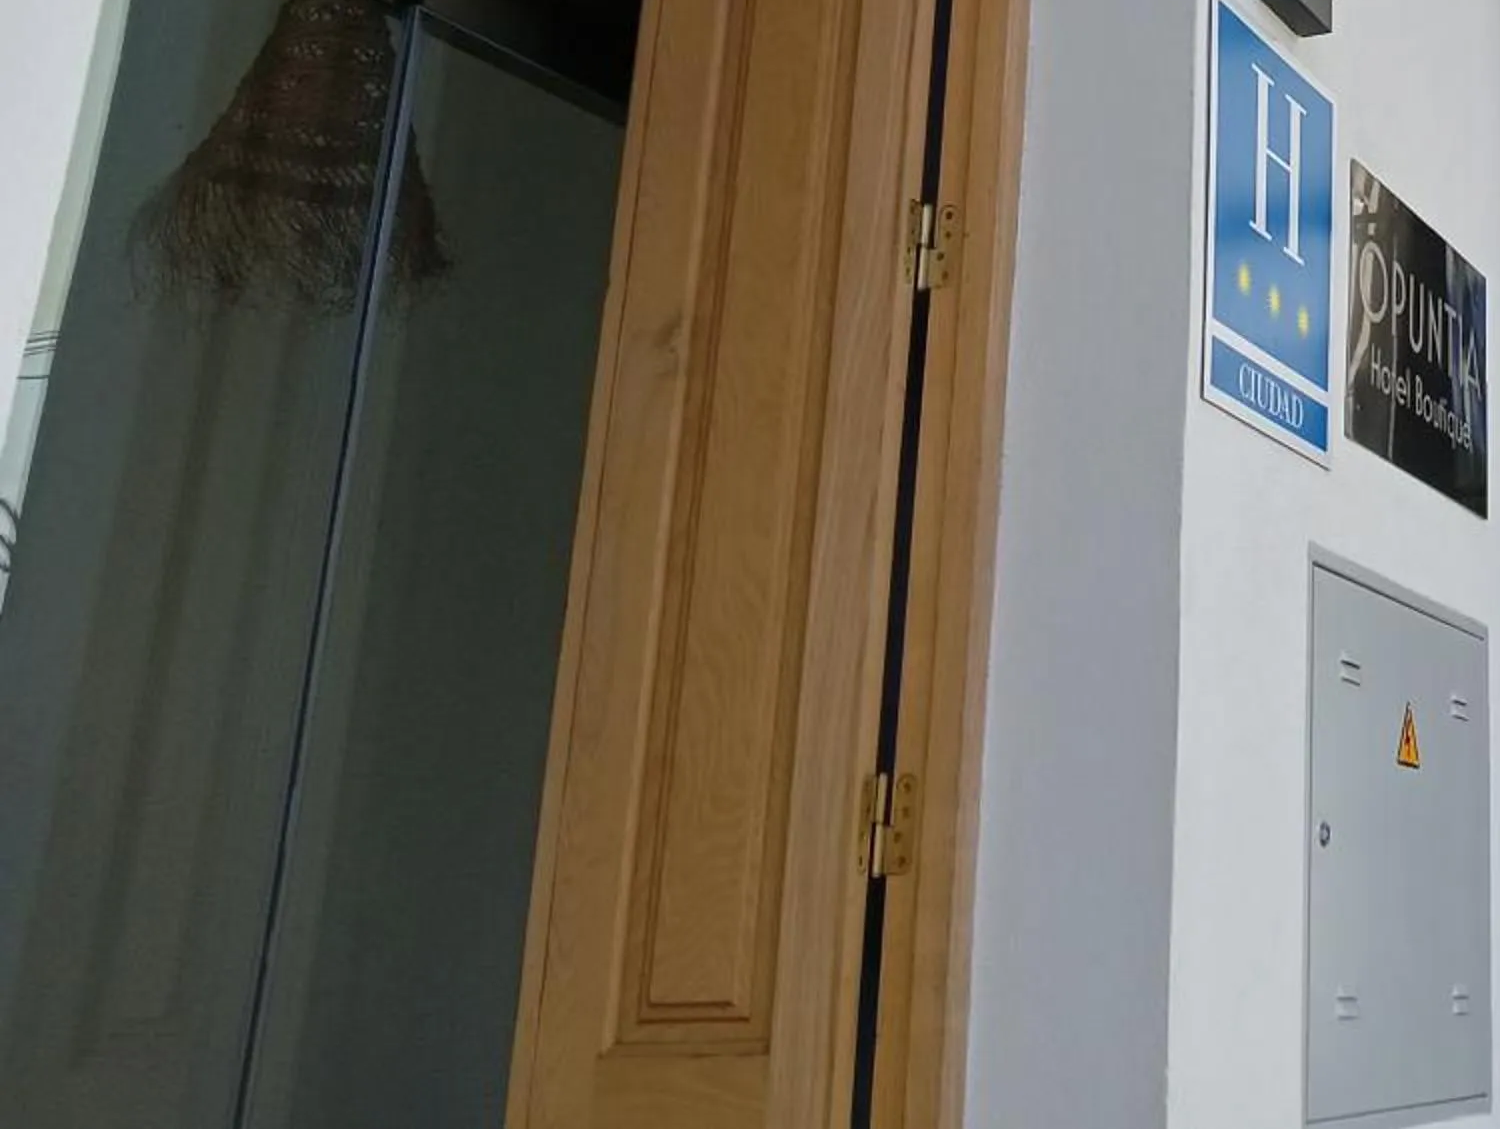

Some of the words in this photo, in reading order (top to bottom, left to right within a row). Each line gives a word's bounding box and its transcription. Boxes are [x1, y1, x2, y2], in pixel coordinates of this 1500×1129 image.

[1249, 63, 1307, 266] H
[1359, 241, 1482, 402] OPUNTIA
[1239, 363, 1304, 429] CIUDAD
[1369, 343, 1411, 409] Hotel
[1414, 374, 1474, 453] Boutique
